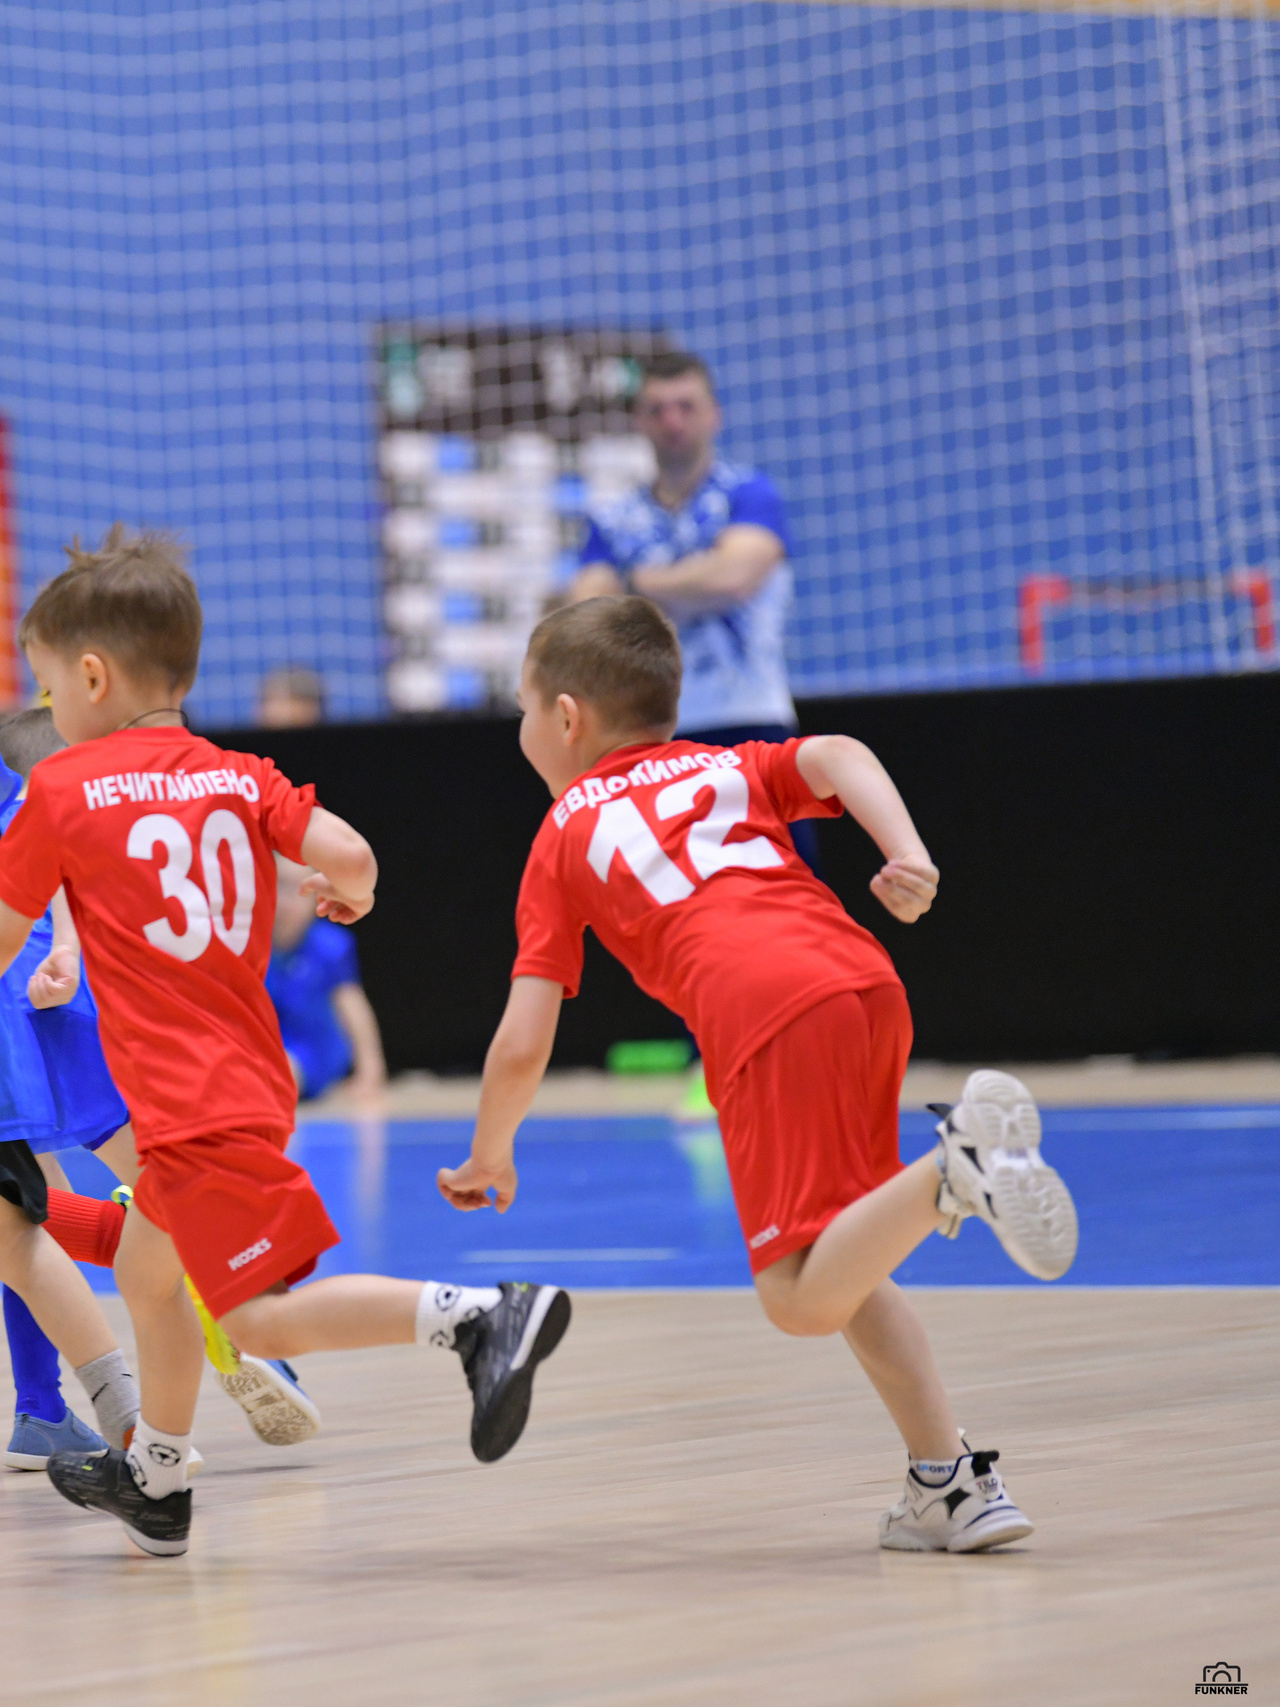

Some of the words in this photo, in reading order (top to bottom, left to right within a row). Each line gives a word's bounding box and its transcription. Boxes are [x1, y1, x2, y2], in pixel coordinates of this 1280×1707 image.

[82, 768, 261, 811] НЕЧИТАЙЛЕНО
[551, 749, 742, 831] ЕВДОКИМОВ
[585, 766, 786, 907] 12
[126, 808, 257, 964] 30
